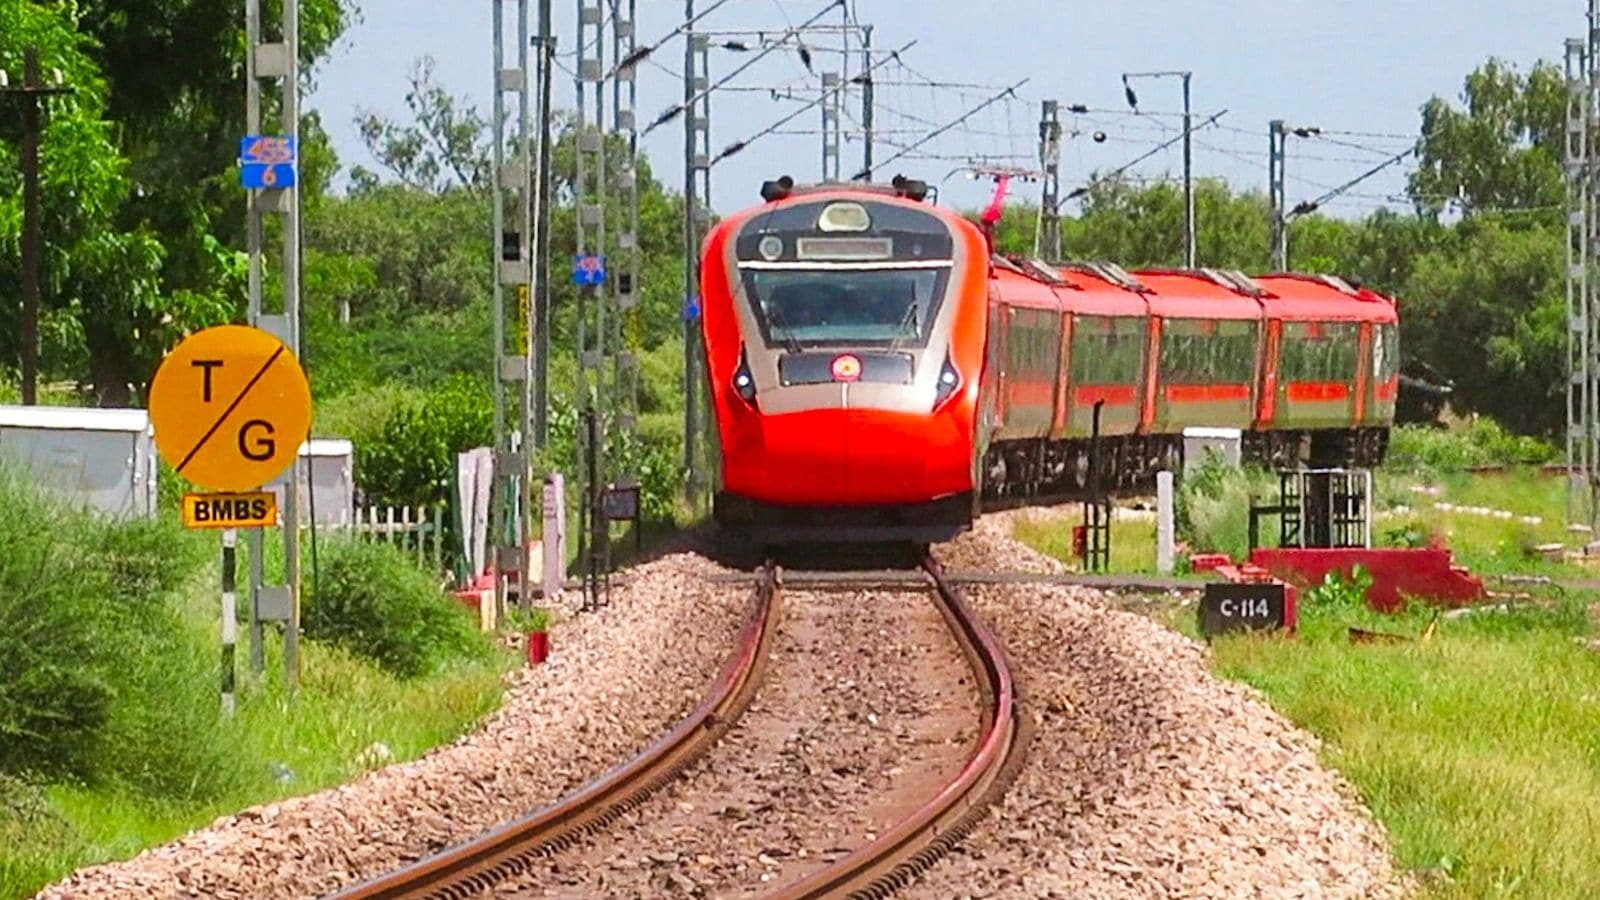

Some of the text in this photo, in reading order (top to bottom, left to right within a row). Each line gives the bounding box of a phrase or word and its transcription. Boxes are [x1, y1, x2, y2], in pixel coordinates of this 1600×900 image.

[263, 165, 276, 186] 6
[191, 360, 224, 403] T
[238, 419, 276, 462] G
[194, 499, 267, 522] BMBS
[1220, 598, 1269, 617] C-114
